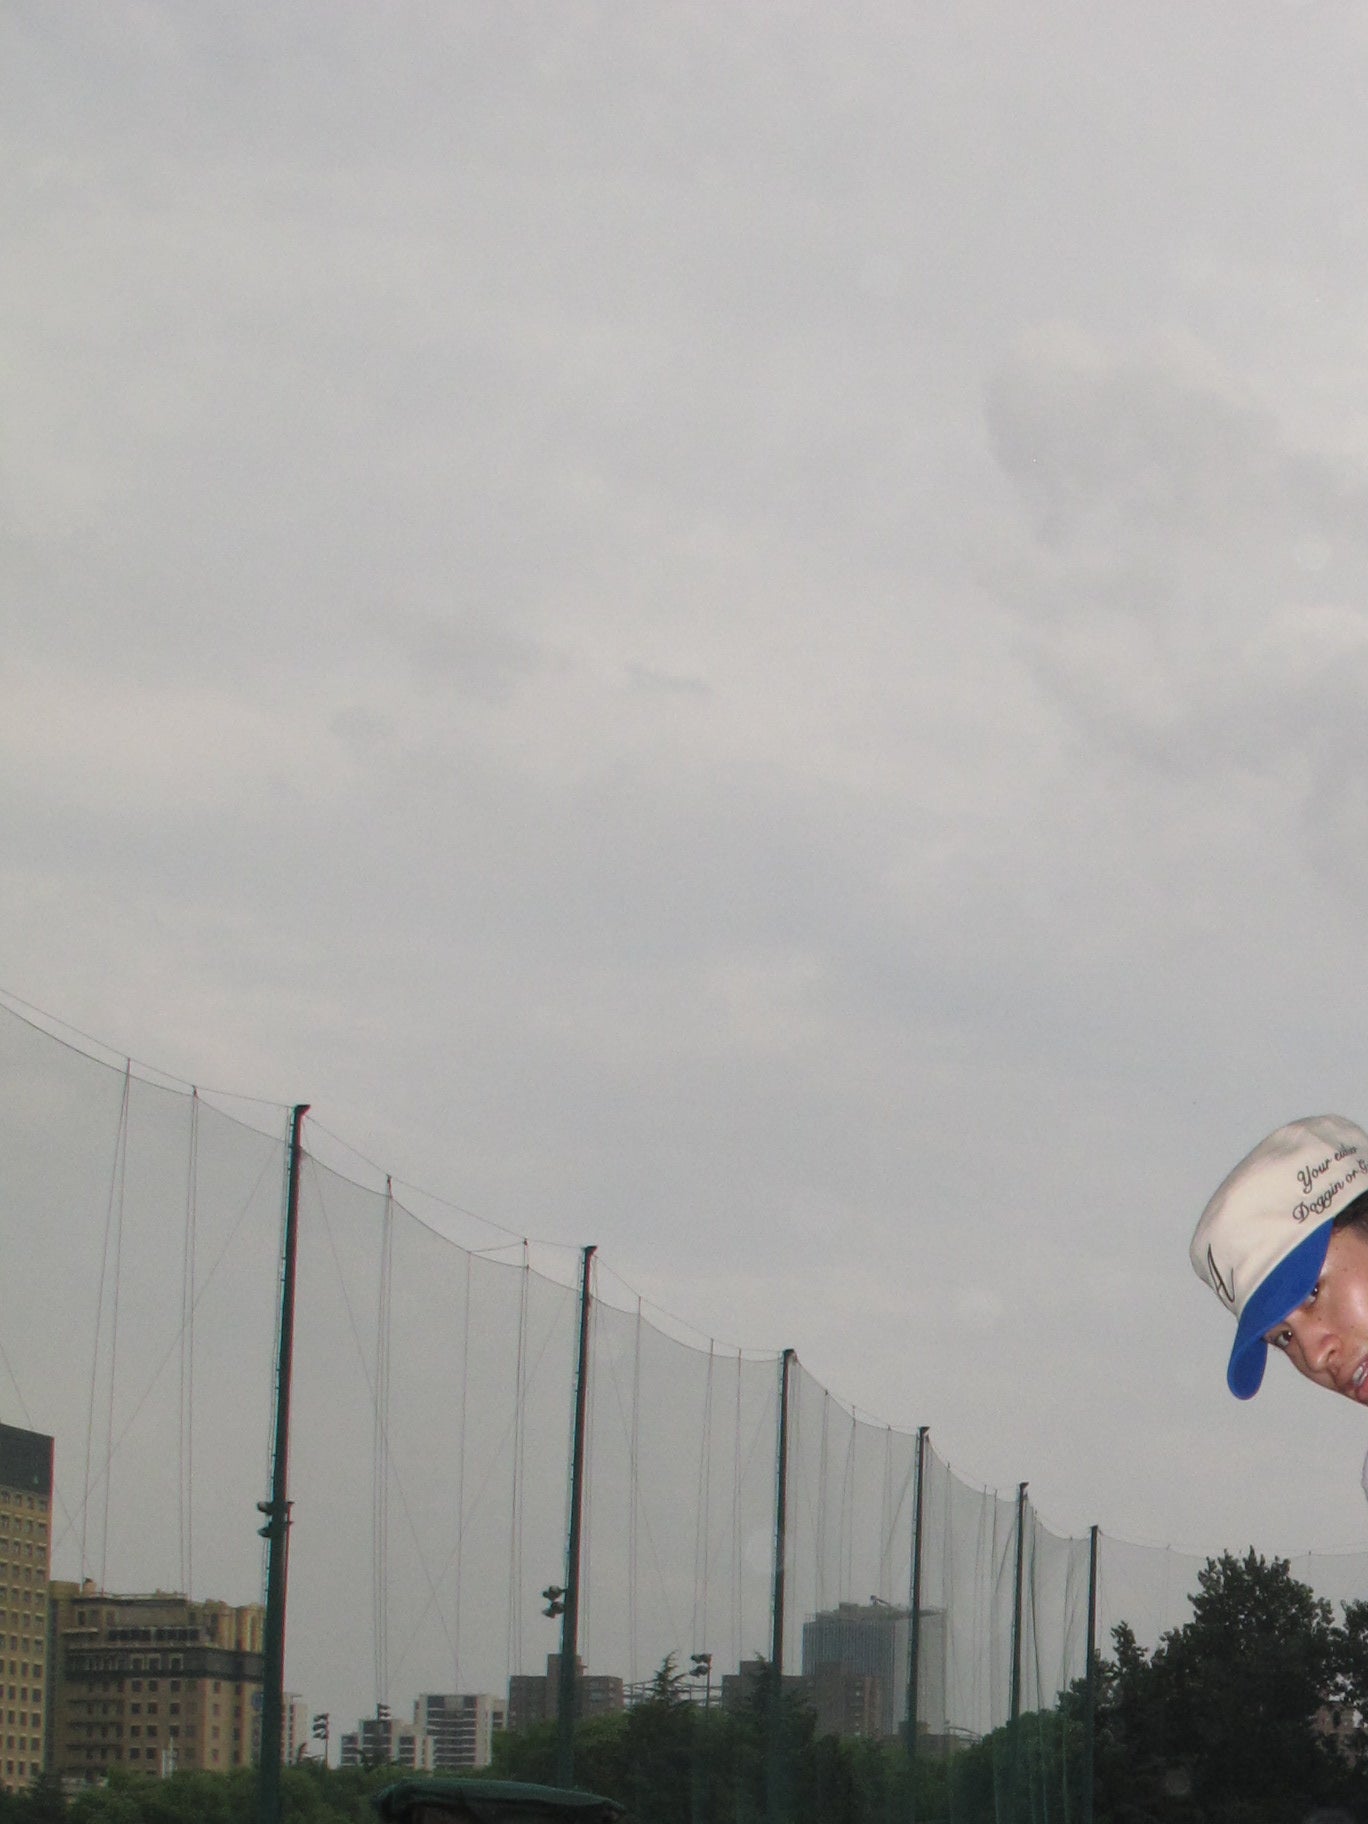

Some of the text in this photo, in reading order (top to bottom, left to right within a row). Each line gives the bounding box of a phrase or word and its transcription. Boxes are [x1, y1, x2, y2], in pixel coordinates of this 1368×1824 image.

[1292, 1179, 1345, 1224] Doggin
[1345, 1168, 1360, 1184] or
[1297, 1159, 1332, 1194] Your
